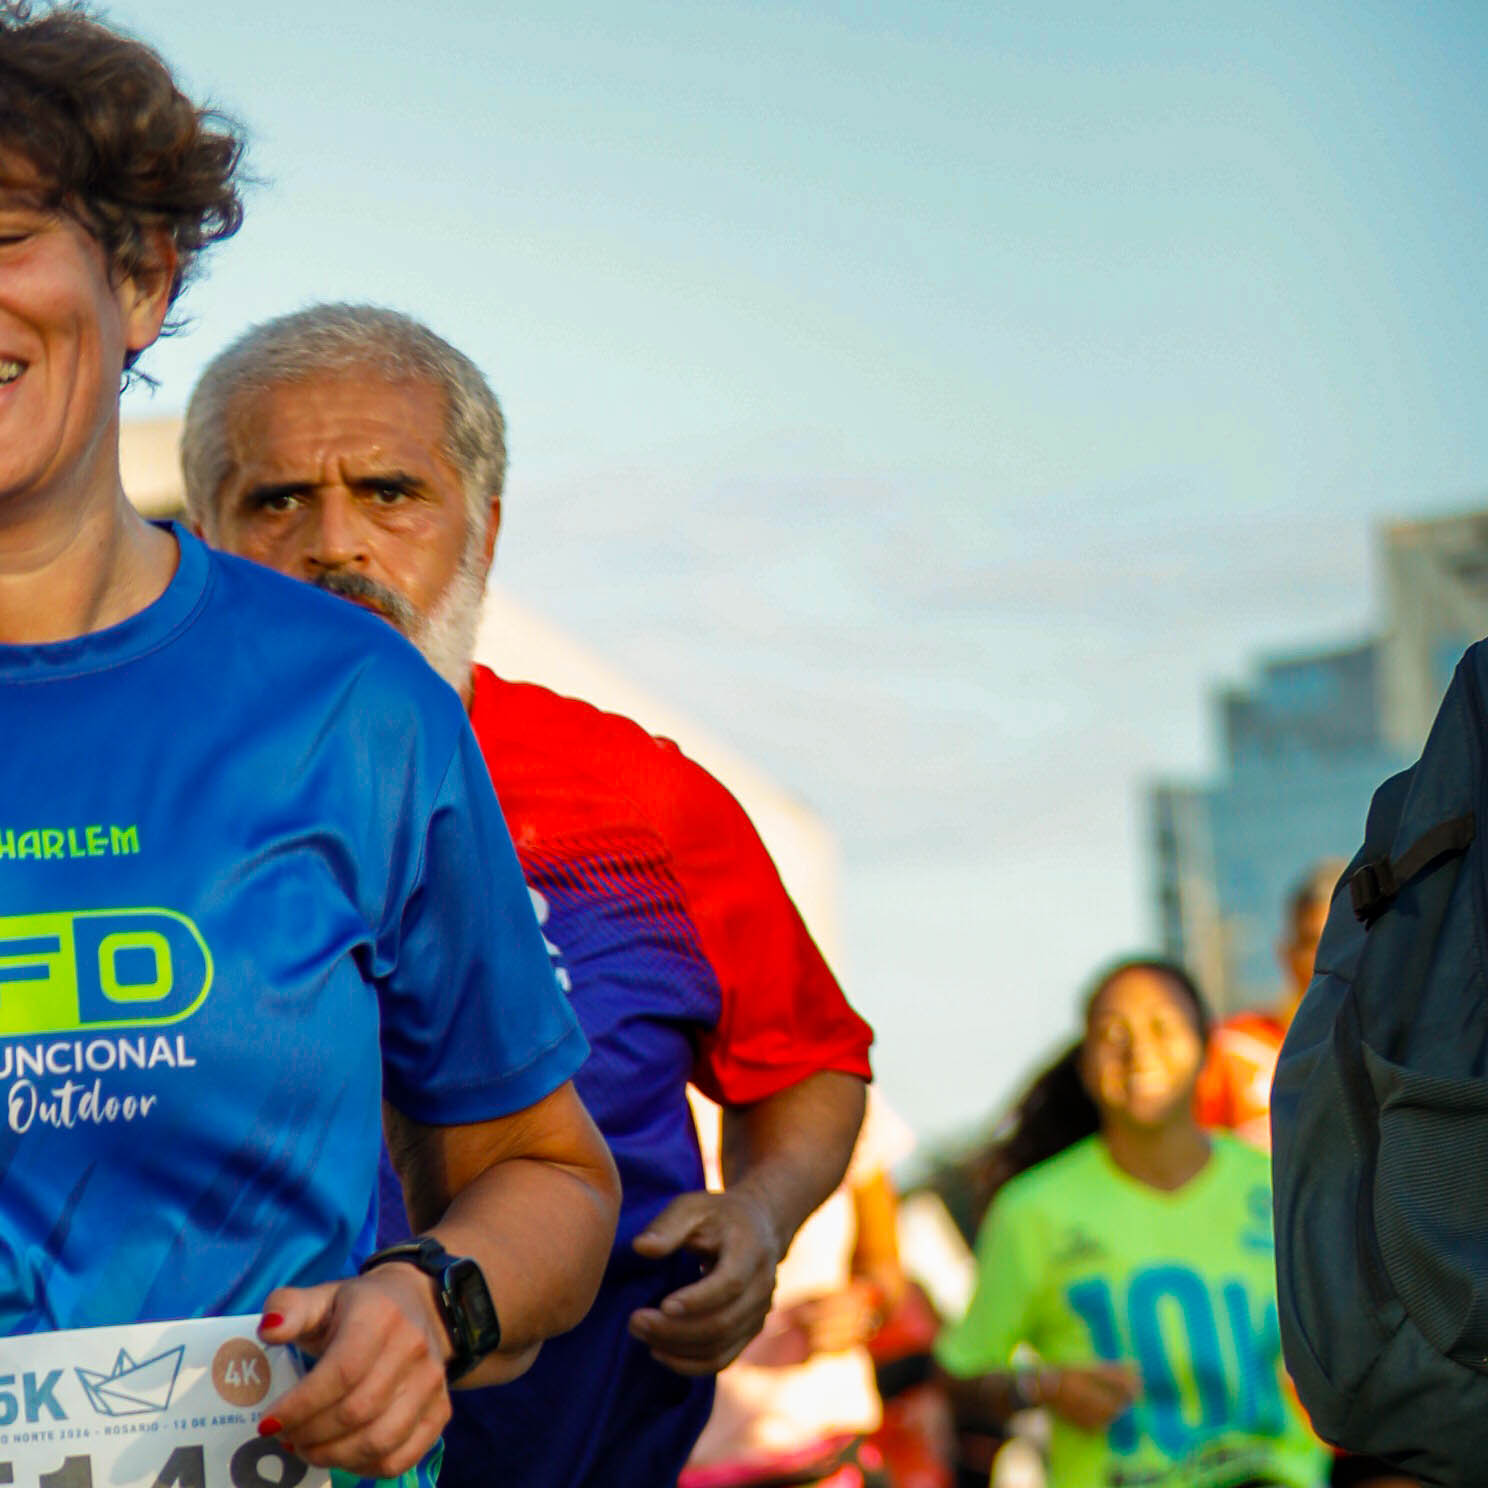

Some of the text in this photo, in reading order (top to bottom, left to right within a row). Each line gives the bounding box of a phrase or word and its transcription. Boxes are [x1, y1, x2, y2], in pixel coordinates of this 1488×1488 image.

[8, 1078, 157, 1134] Outdoor
[223, 1354, 261, 1389] 4K
[13, 1430, 55, 1443] NORTE
[104, 1422, 159, 1436] ROSARIO
[191, 1417, 207, 1428] DE
[211, 1413, 246, 1426] ABRIL
